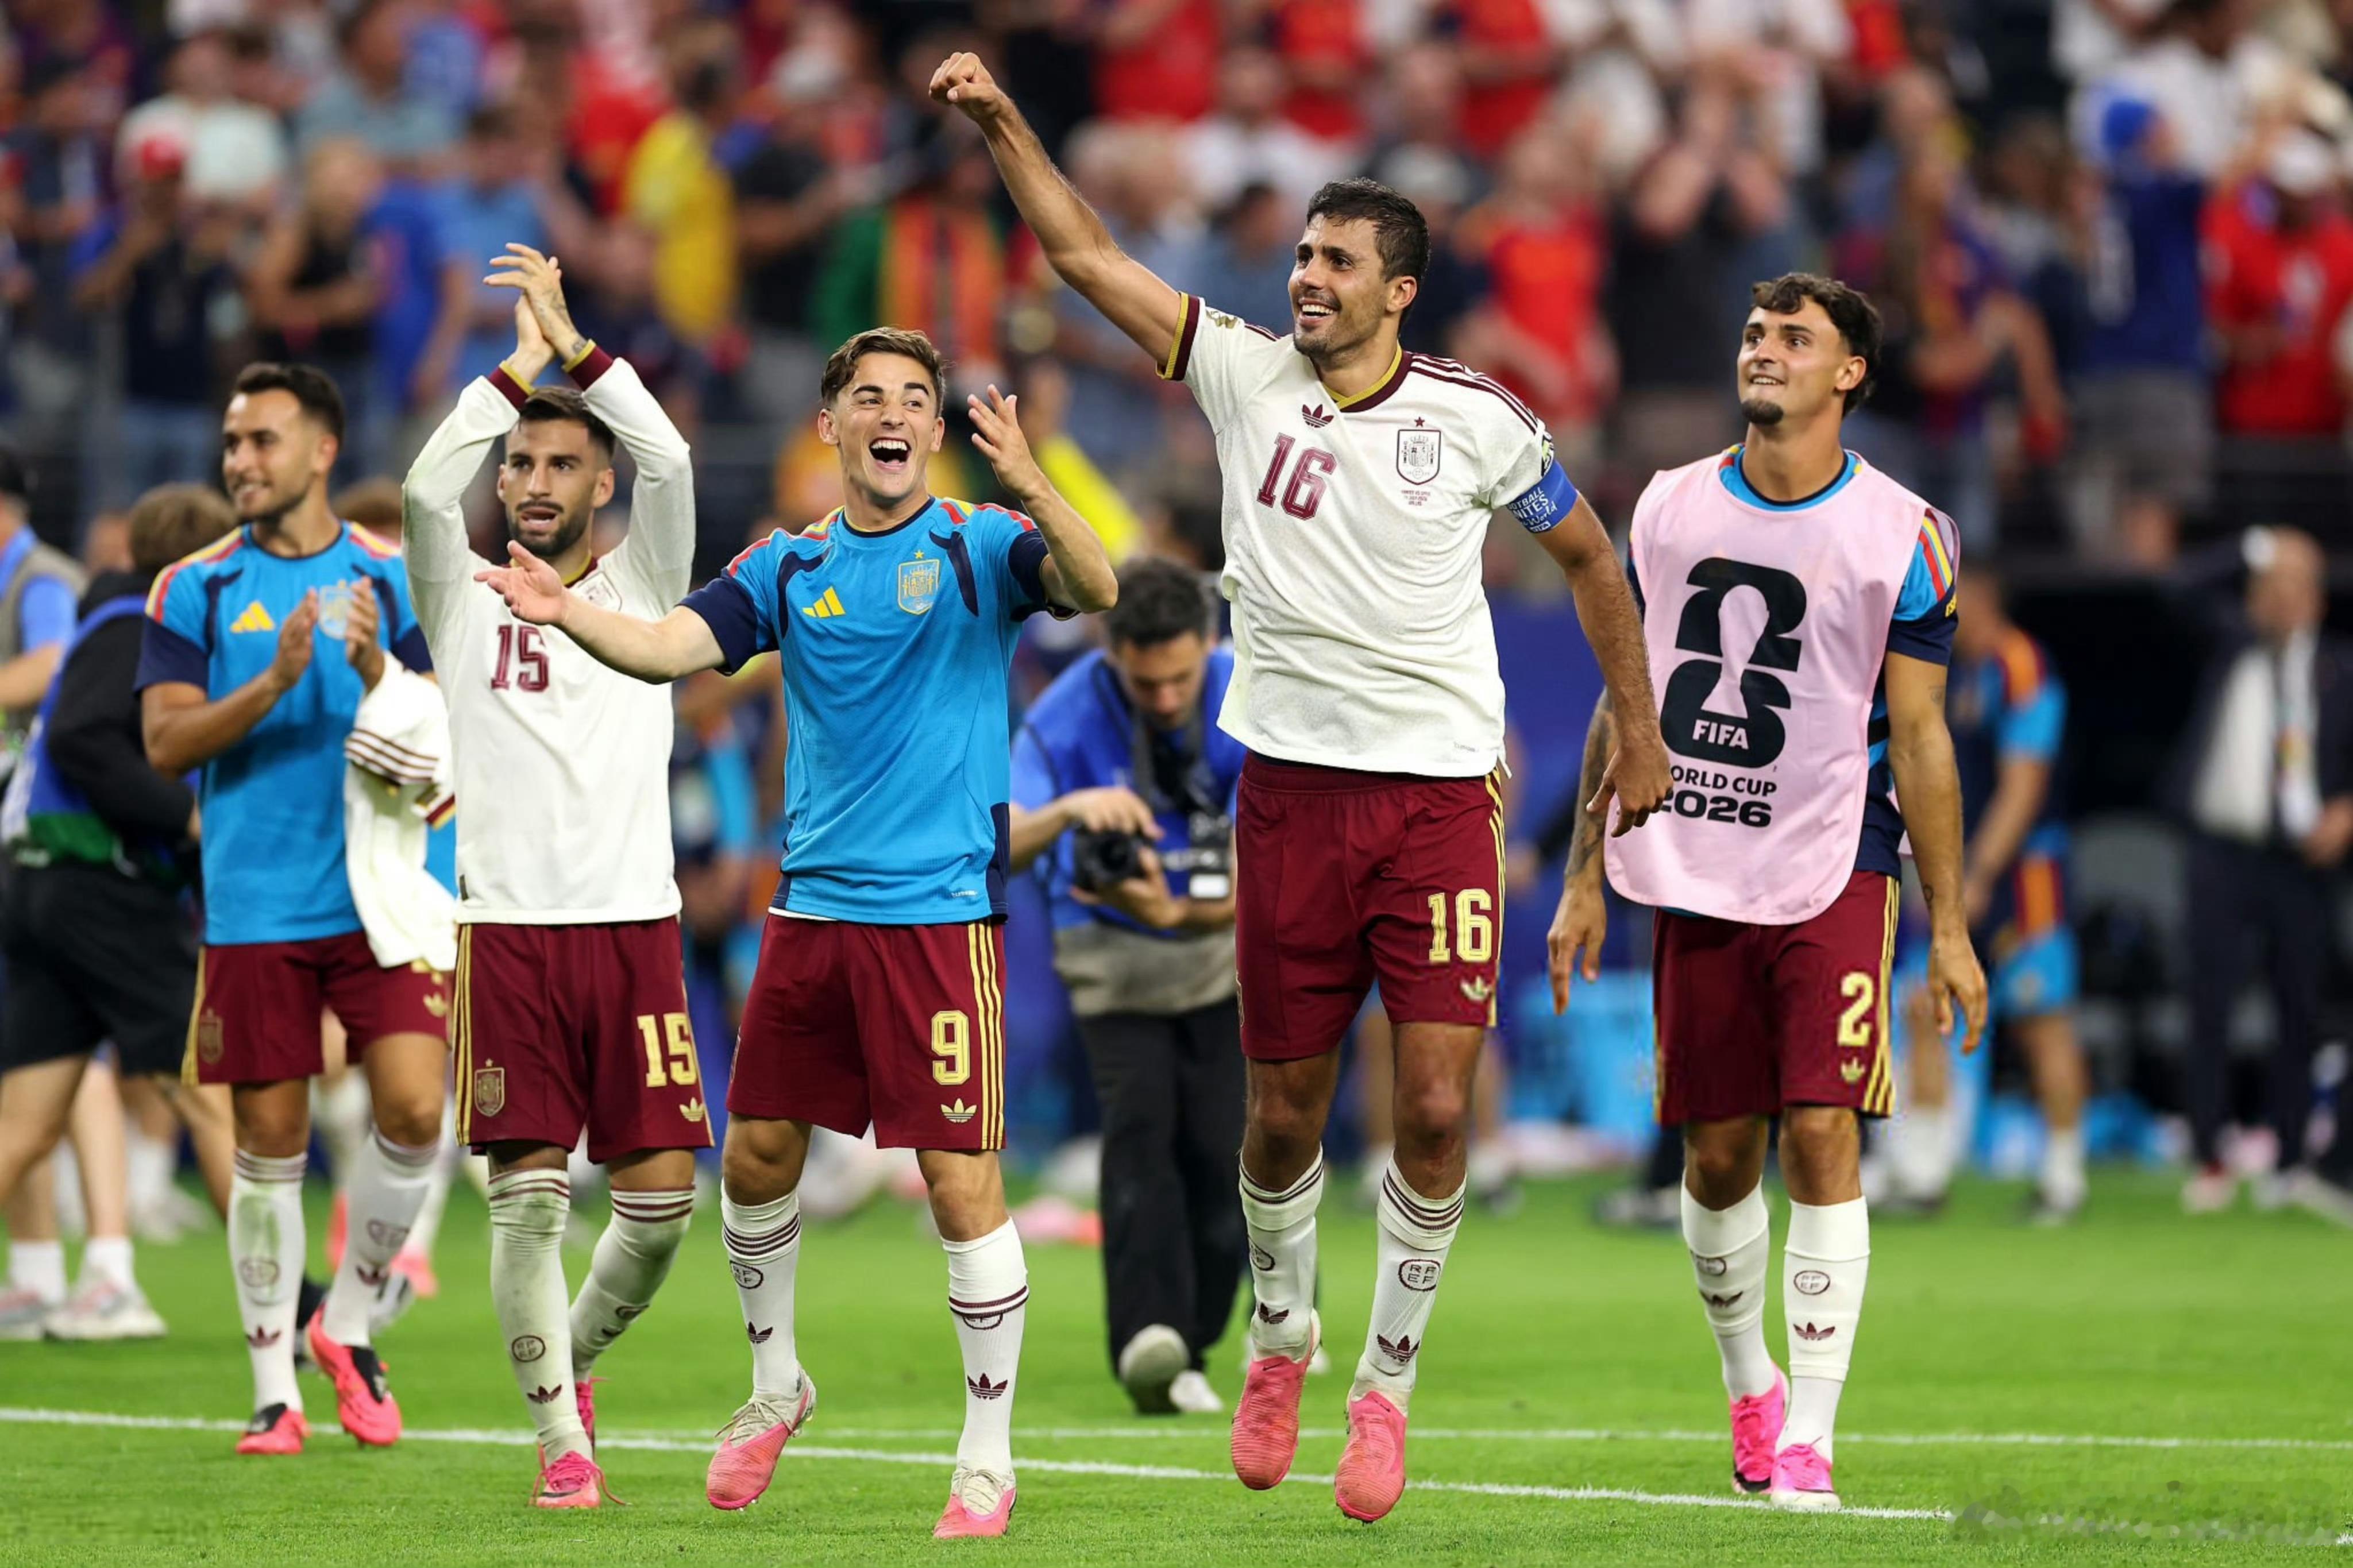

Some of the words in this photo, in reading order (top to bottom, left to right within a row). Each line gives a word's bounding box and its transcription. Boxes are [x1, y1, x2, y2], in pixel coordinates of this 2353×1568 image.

[1256, 432, 1337, 521] 16
[491, 624, 549, 693] 15
[1692, 719, 1749, 750] FIFA
[1670, 765, 1728, 790] ORLD
[1733, 777, 1777, 797] CUP
[1428, 888, 1492, 963] 16
[1838, 972, 1873, 1046] 2
[637, 1012, 697, 1087] 15
[931, 1010, 970, 1085] 9
